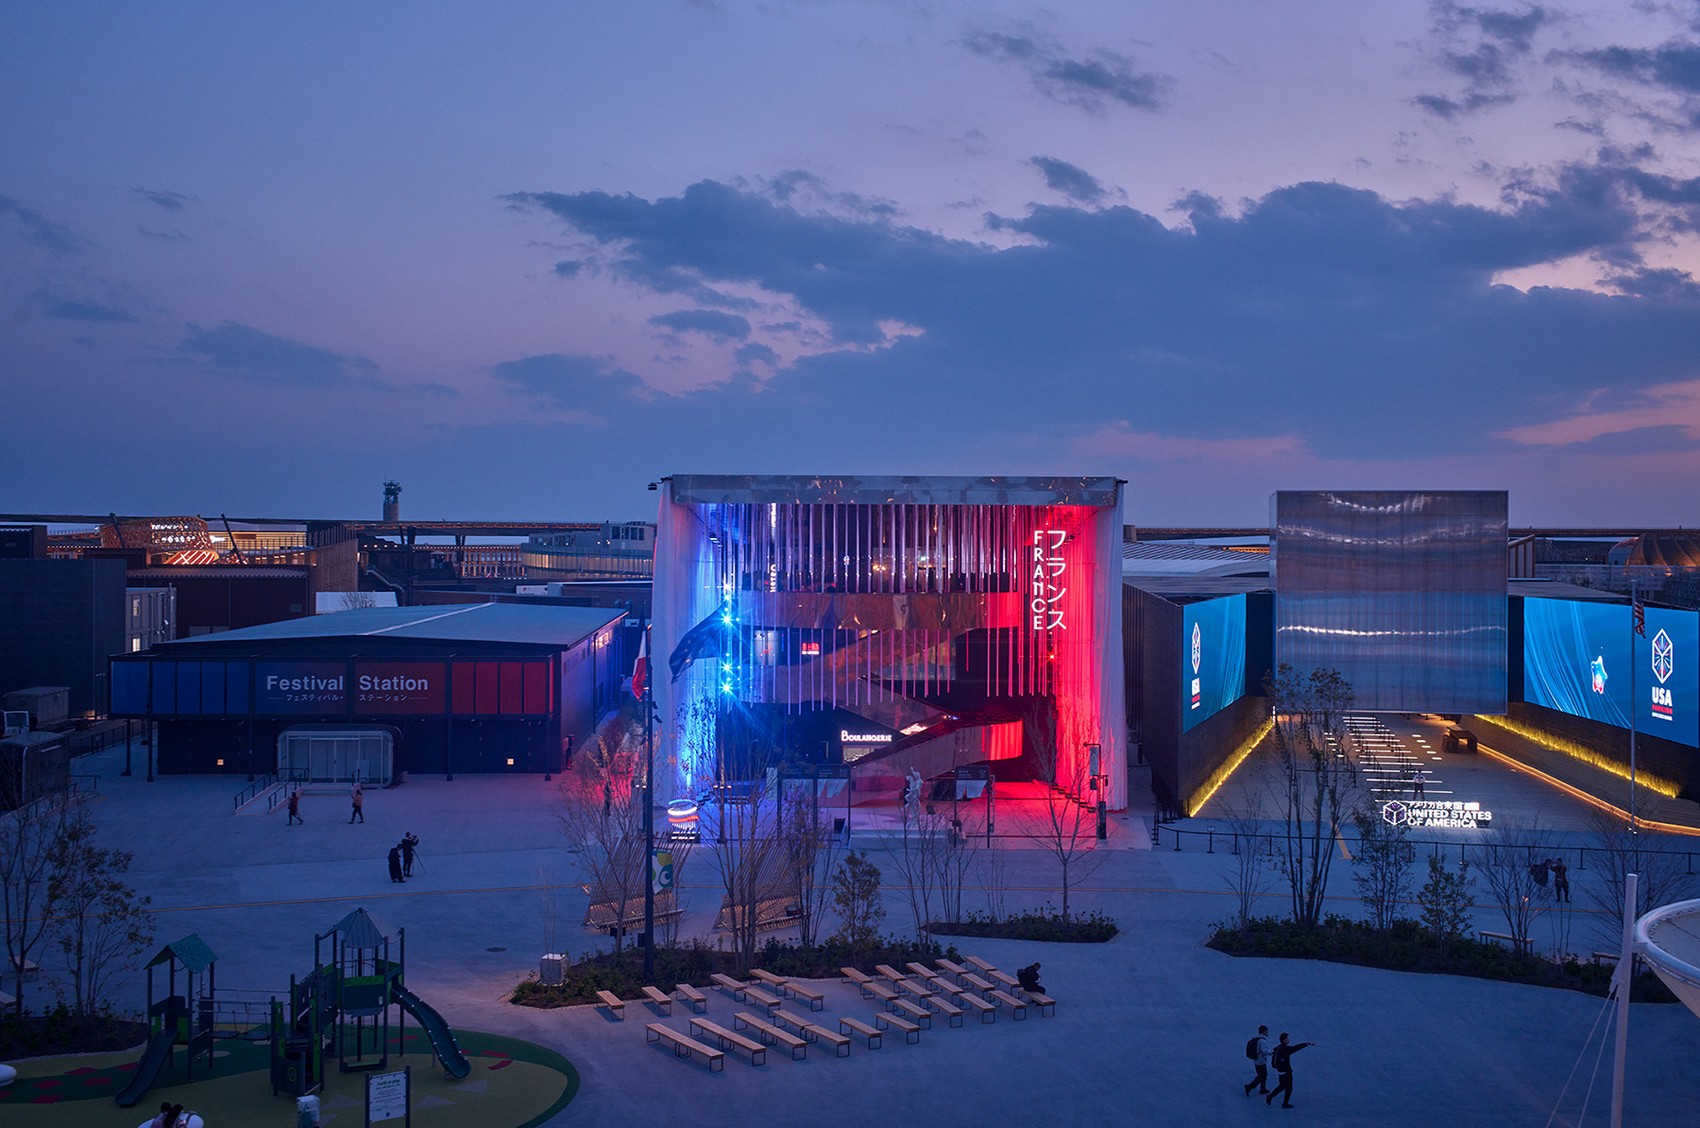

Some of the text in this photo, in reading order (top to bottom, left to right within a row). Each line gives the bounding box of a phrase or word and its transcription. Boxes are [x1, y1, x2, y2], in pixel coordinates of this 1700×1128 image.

[1031, 530, 1046, 630] FRANCE
[1047, 530, 1067, 630] フランス
[266, 675, 429, 691] Festival Station
[1651, 686, 1673, 707] USA
[1407, 809, 1492, 820] UNITED STATES
[1407, 818, 1477, 828] OF AMERICA
